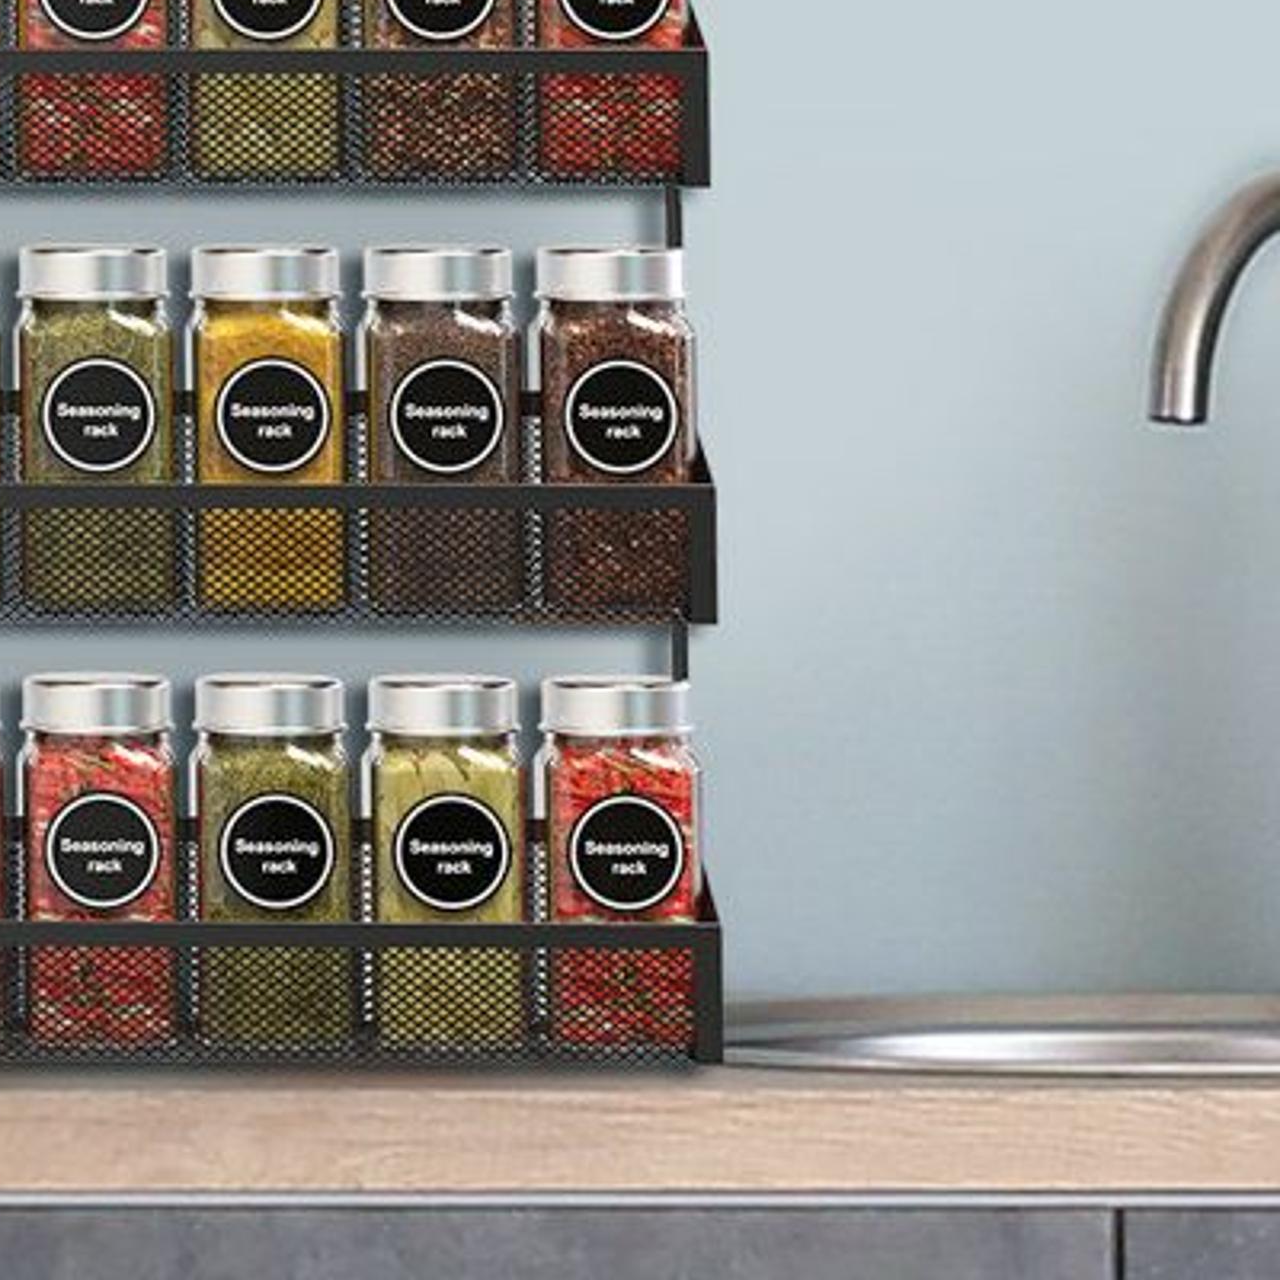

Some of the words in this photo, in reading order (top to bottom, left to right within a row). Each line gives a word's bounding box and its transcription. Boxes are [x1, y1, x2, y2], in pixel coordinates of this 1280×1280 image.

[57, 402, 142, 421] Seasoning
[230, 402, 315, 421] Seasoning
[405, 402, 490, 421] Seasoning
[578, 403, 664, 422] Seasoning
[83, 422, 119, 437] rack
[257, 423, 292, 438] rack
[431, 423, 467, 439] rack
[605, 425, 641, 439] rack
[60, 837, 145, 856] Seasoning
[235, 838, 320, 857] Seasoning
[409, 838, 494, 858] Seasoning
[584, 840, 670, 859] Seasoning
[86, 859, 123, 873] rack
[261, 859, 296, 874] rack
[437, 860, 472, 875] rack
[611, 860, 647, 875] rack
